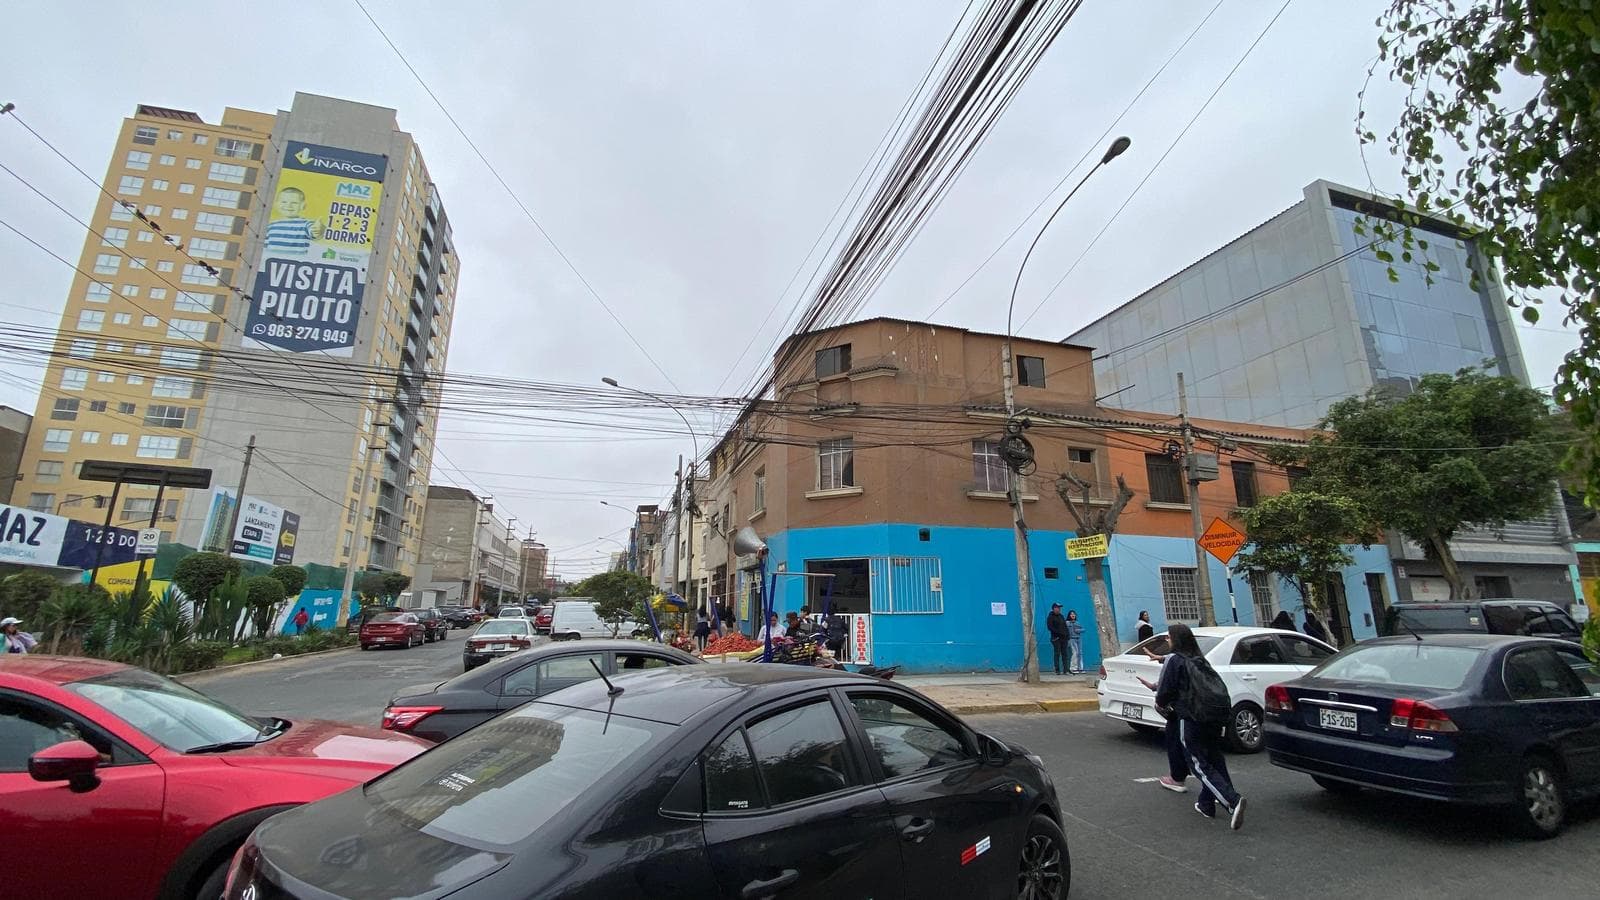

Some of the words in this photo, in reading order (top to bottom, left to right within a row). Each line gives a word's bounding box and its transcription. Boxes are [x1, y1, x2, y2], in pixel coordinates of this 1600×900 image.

[313, 158, 377, 175] INARCO
[336, 182, 371, 196] MAZ
[330, 202, 371, 219] DEPAS
[325, 229, 367, 244] DORMS
[269, 262, 353, 296] VISITA
[258, 290, 353, 324] PILOTO
[267, 323, 293, 338] 983
[295, 326, 320, 341] 274
[322, 329, 348, 344] 949
[1203, 539, 1241, 549] VELOCIDAD
[1204, 531, 1237, 541] DISMINUIR
[1321, 713, 1356, 729] F1S-205
